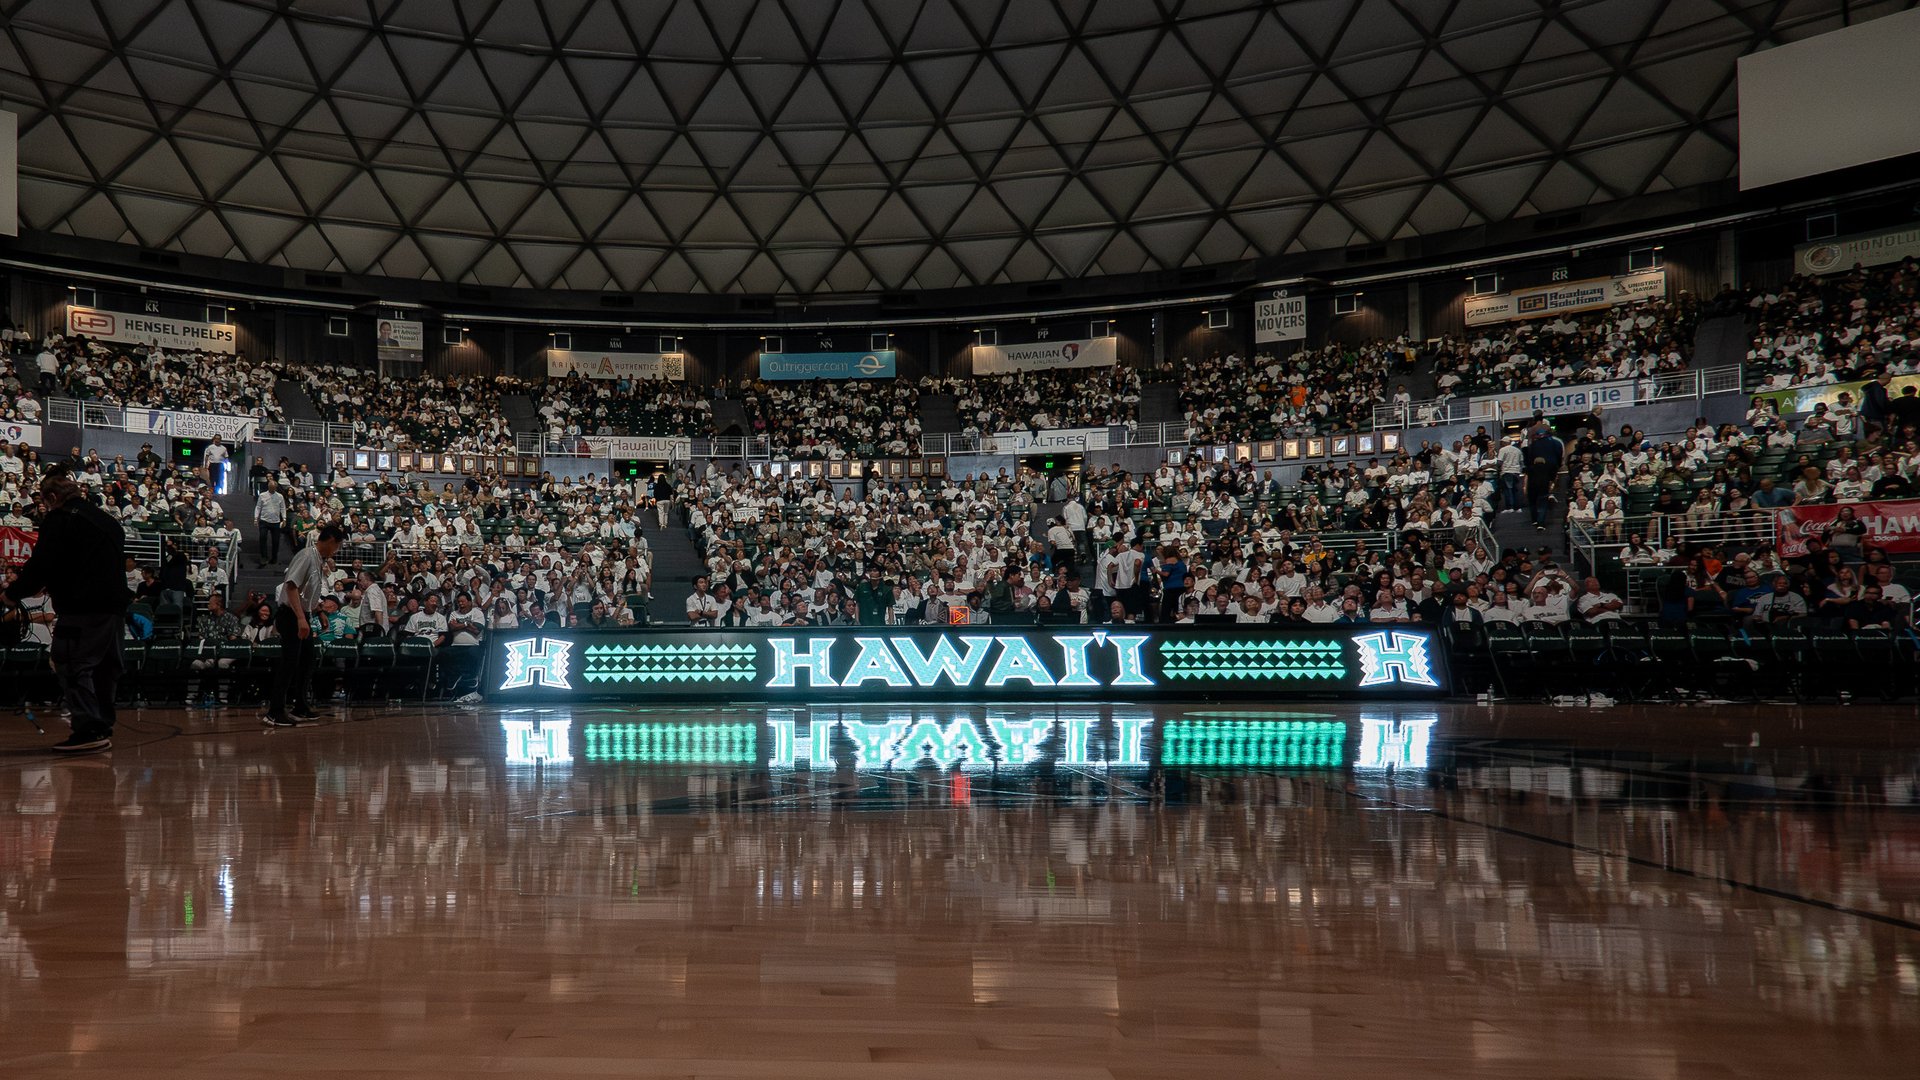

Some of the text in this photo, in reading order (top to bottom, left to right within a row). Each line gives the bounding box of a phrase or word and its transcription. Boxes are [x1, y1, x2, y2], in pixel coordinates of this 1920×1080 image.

[1552, 270, 1568, 280] RR
[1549, 288, 1604, 300] Roadway
[145, 302, 159, 313] KK
[1549, 296, 1604, 309] Solutions
[1259, 301, 1302, 317] ISLAND
[1257, 314, 1305, 331] MOVERS
[125, 319, 233, 342] HENSEL PHELPS
[1037, 330, 1049, 339] PP
[609, 341, 622, 349] MM
[820, 341, 833, 349] NN
[1007, 350, 1060, 361] HAWAIIAN
[615, 363, 659, 371] AUTHENTICS
[769, 361, 848, 374] Outrigger.com
[175, 413, 239, 425] DIAGNOSTIC
[175, 420, 239, 432] LABORATORY
[175, 428, 220, 439] SERVICE
[1029, 435, 1085, 447] ALTRES
[4, 538, 36, 557] HA
[499, 637, 573, 690] H
[1351, 631, 1439, 687] H
